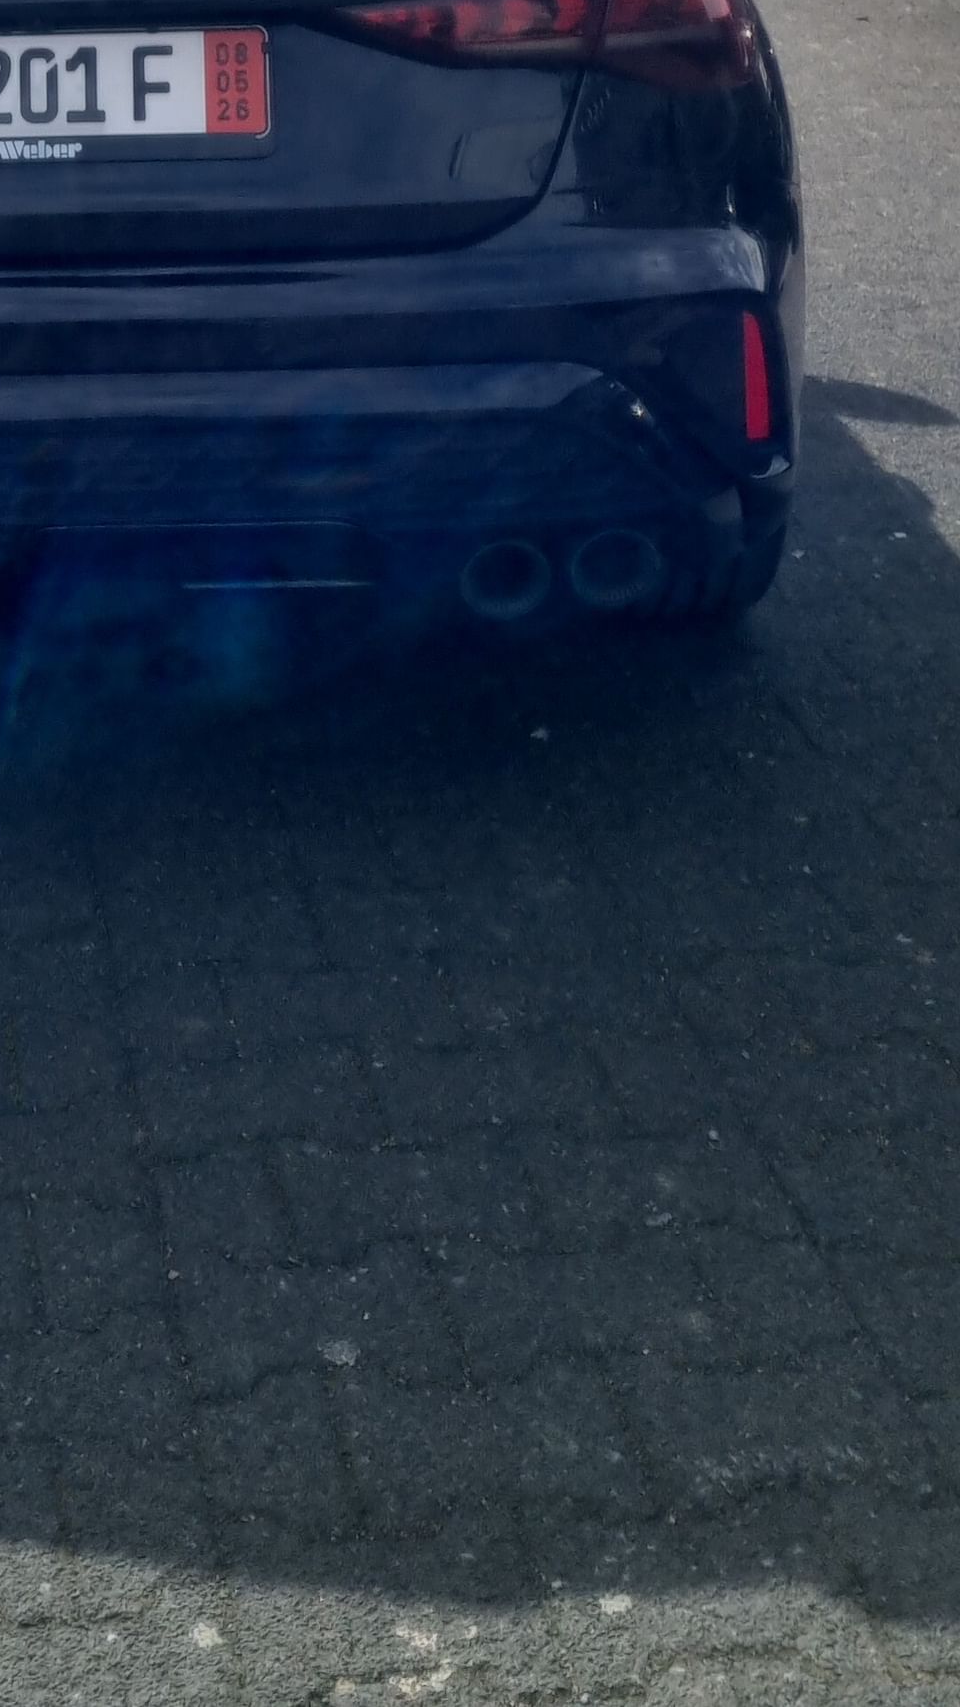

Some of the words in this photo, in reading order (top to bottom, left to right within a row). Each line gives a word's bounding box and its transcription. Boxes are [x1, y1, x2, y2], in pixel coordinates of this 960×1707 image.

[132, 45, 174, 122] F
[216, 69, 249, 93] 05
[217, 98, 250, 122] 26
